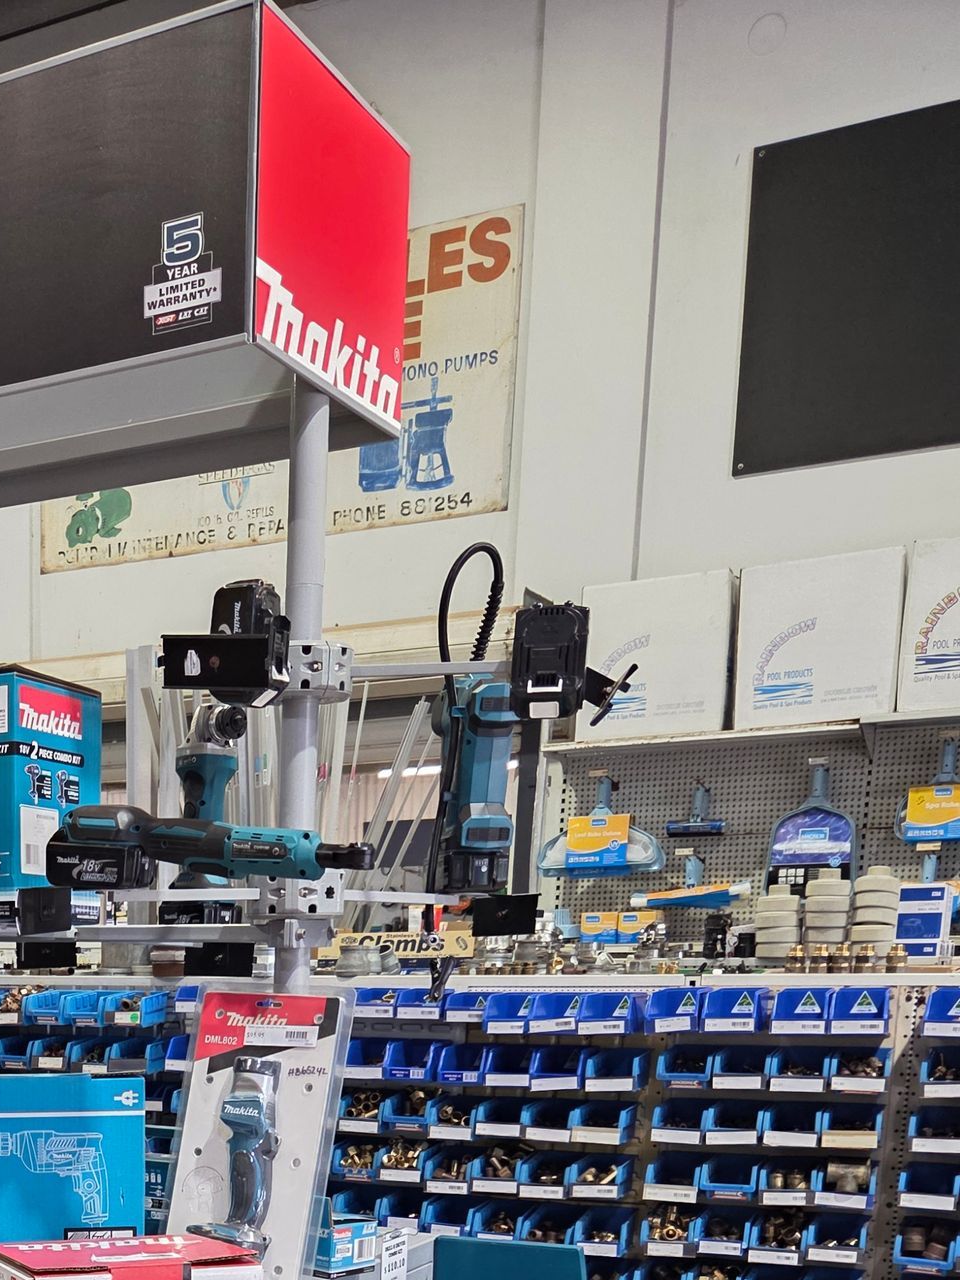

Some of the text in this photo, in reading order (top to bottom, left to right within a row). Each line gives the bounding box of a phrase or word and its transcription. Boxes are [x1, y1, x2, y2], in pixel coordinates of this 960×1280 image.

[162, 213, 203, 267] 5
[166, 262, 198, 280] YEAR
[158, 278, 206, 297] LIMITED
[444, 350, 499, 374] PUMPS
[933, 639, 951, 650] POOL
[767, 668, 814, 682] POOL PRODUCTS
[19, 741, 81, 765] 18V 2 PIECE COMBO KIT
[204, 1035, 237, 1045] DML802
